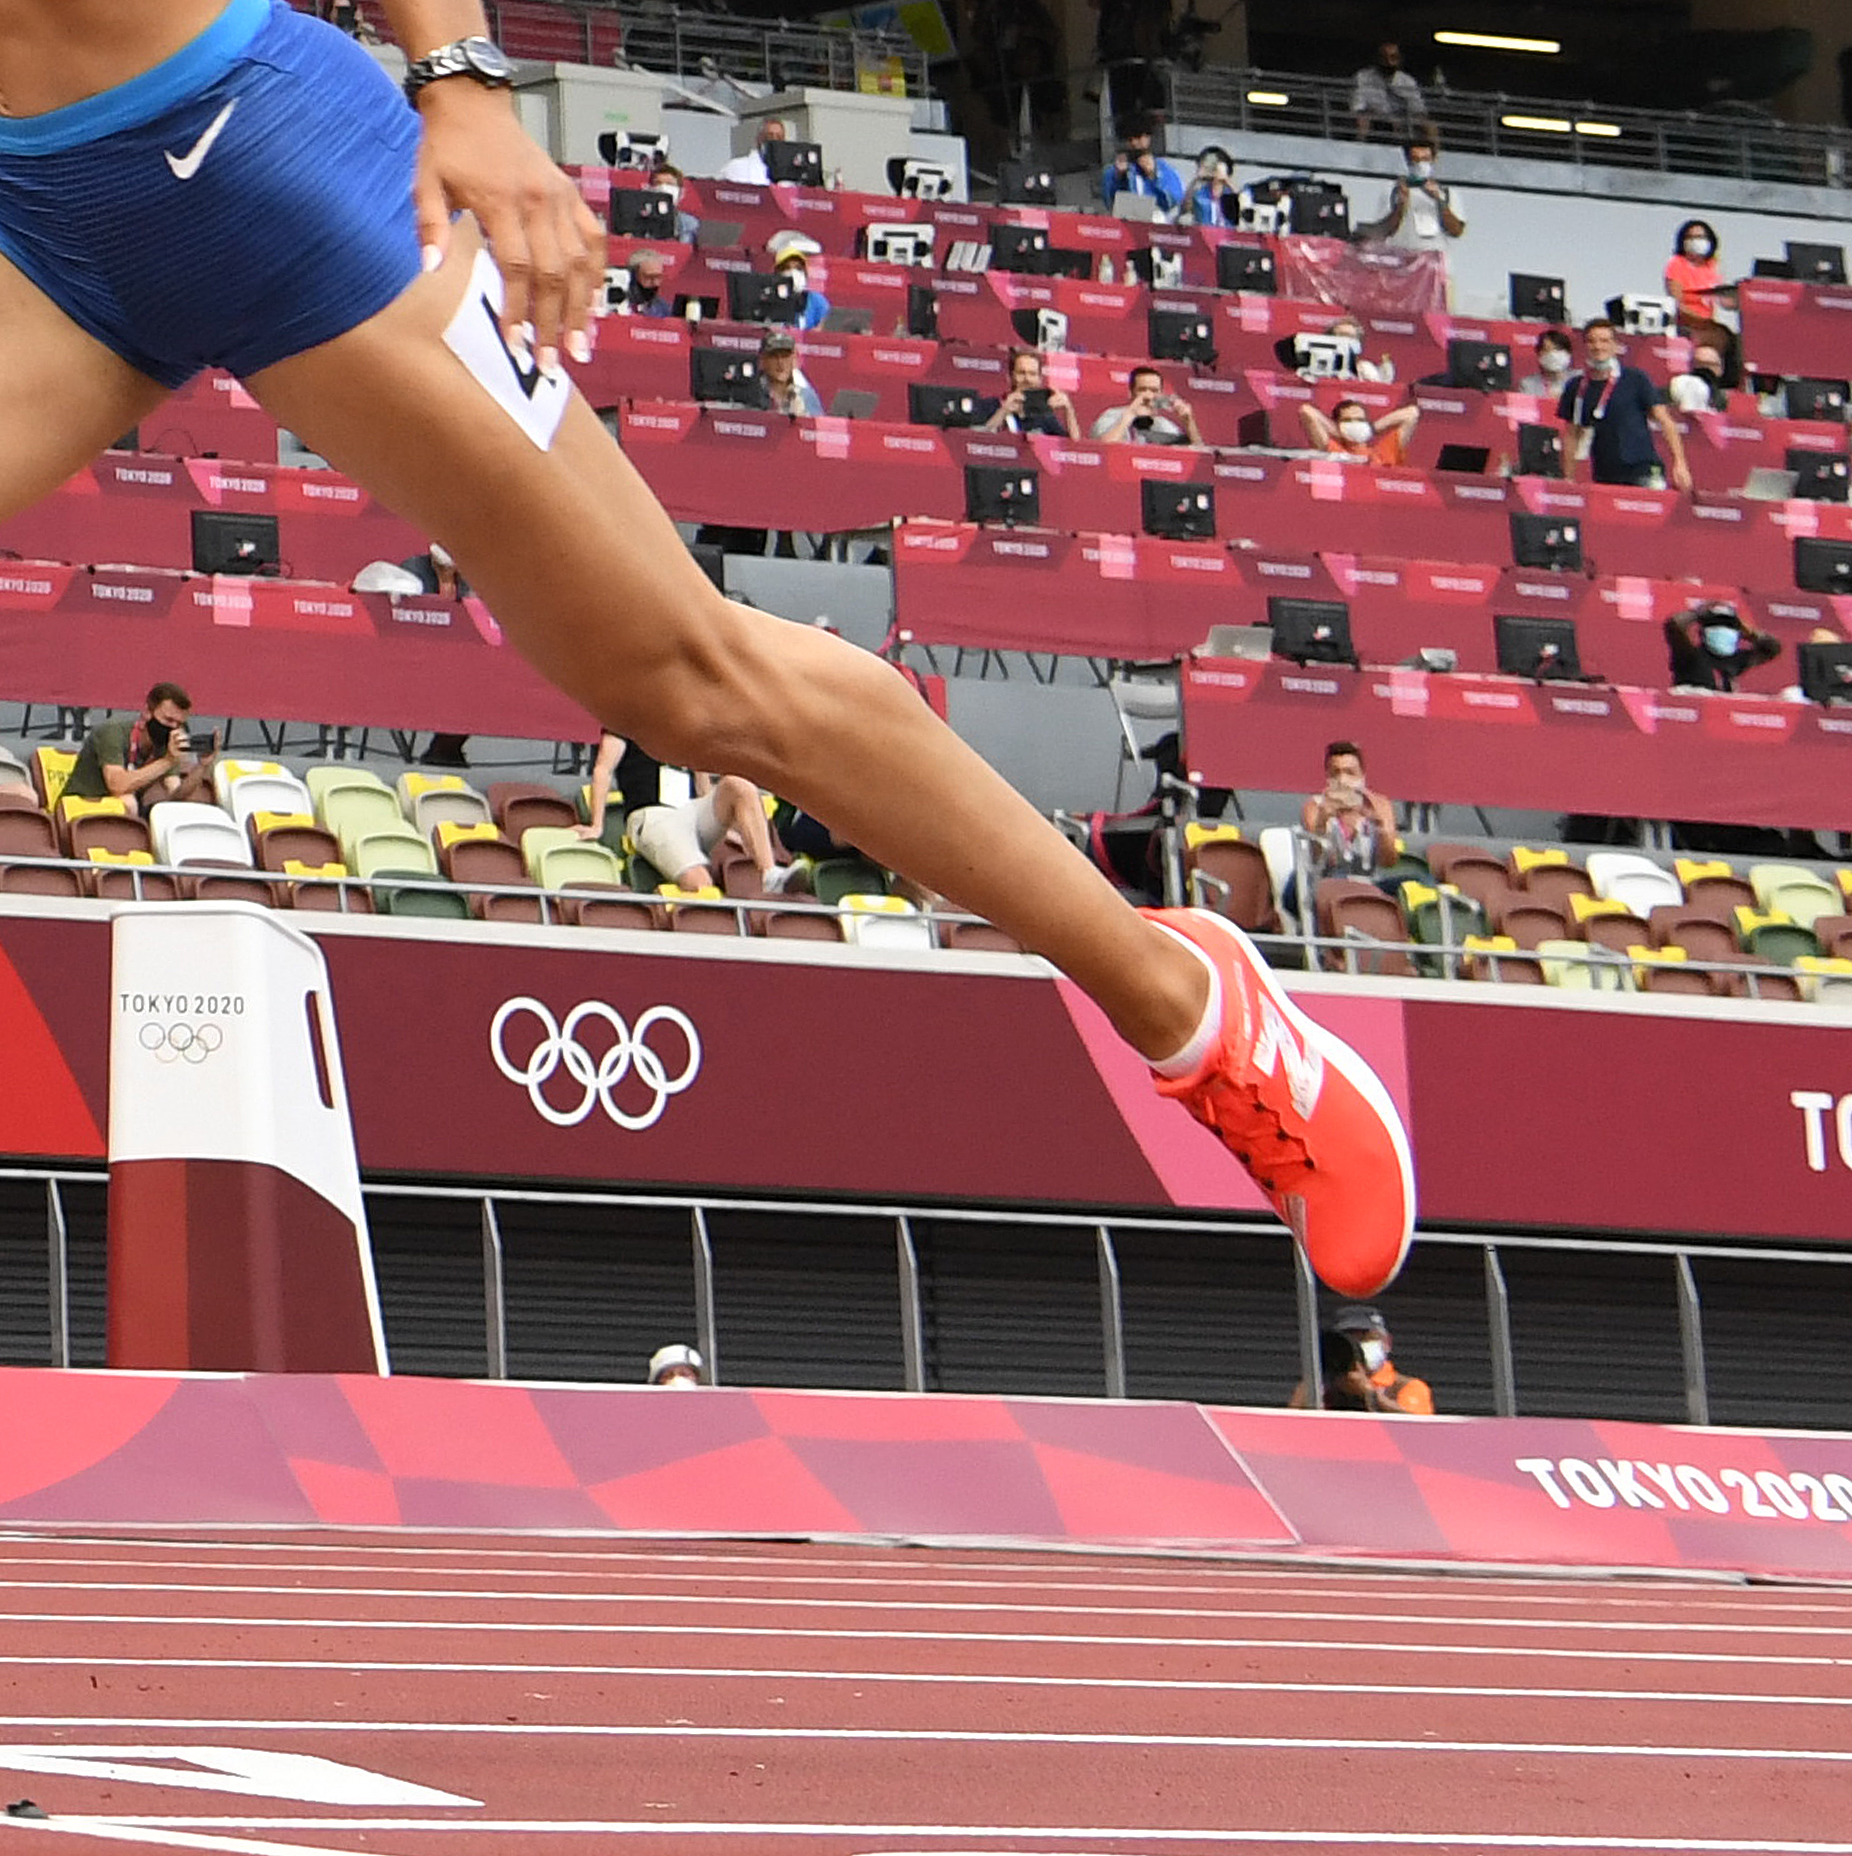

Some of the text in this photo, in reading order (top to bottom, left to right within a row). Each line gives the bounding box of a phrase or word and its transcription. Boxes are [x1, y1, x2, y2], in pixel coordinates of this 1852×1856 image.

[121, 995, 244, 1015] TOKYO 2020
[1515, 1457, 1729, 1516] TOKYO
